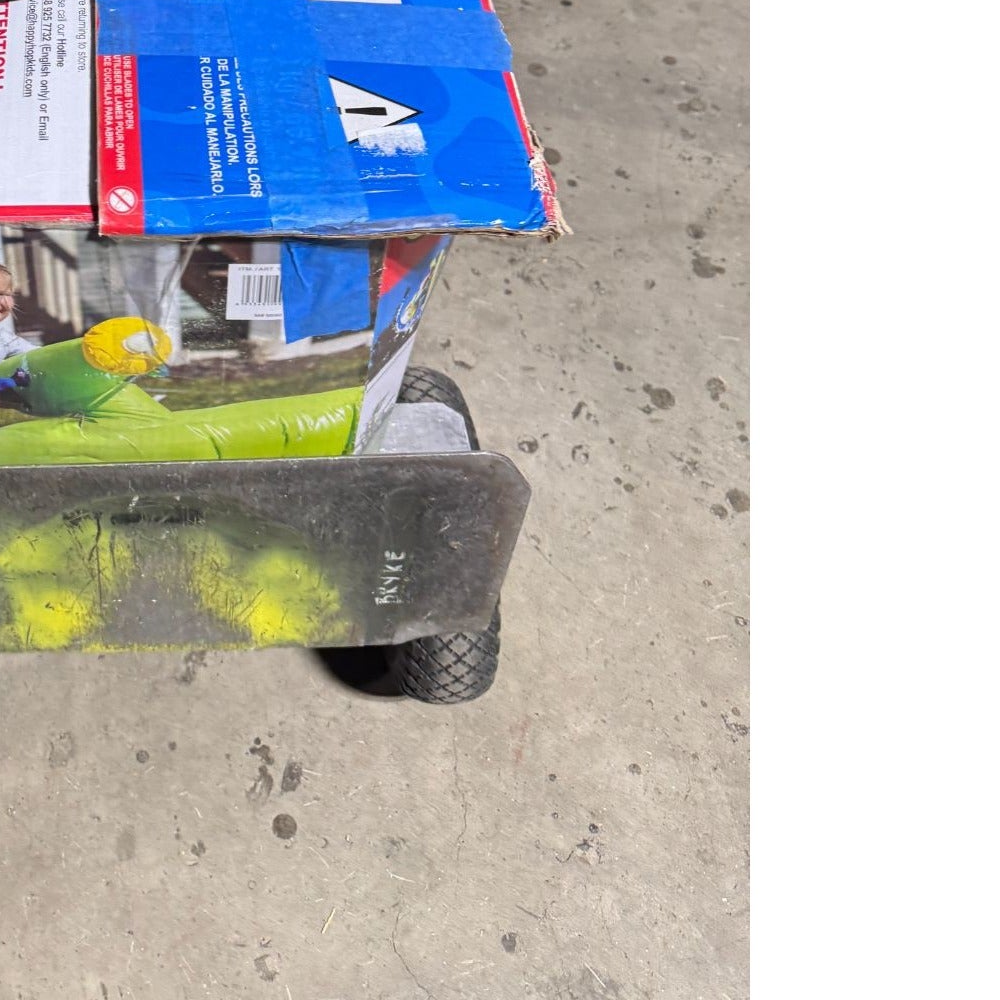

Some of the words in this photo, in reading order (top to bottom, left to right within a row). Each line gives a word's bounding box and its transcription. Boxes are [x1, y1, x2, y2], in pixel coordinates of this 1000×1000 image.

[42, 7, 52, 21] 925
[57, 9, 67, 22] call
[76, 7, 87, 40] returning
[41, 23, 51, 41] 7732
[56, 38, 67, 67] Hotline
[78, 42, 86, 50] to
[38, 43, 51, 77] (English
[77, 51, 86, 73] store.
[216, 58, 229, 71] DE
[37, 79, 50, 101] only)
[104, 67, 113, 106] CUCHILLAS
[113, 85, 122, 94] DE
[124, 70, 133, 98] BLADES
[200, 66, 215, 110] CUIDADO
[218, 74, 230, 86] LA
[39, 103, 48, 113] or
[114, 96, 124, 119] LAMES
[125, 99, 133, 108] TO
[105, 107, 113, 125] PARA
[125, 109, 134, 129] OPEN
[204, 112, 216, 125] AL
[220, 88, 239, 166] MANIPULATION.
[38, 116, 49, 141] Email
[105, 126, 114, 148] ABRIR
[115, 121, 124, 141] POUR
[116, 143, 125, 170] OUVRIR
[206, 127, 225, 197] MANEJARLO.
[247, 167, 263, 198] LORS
